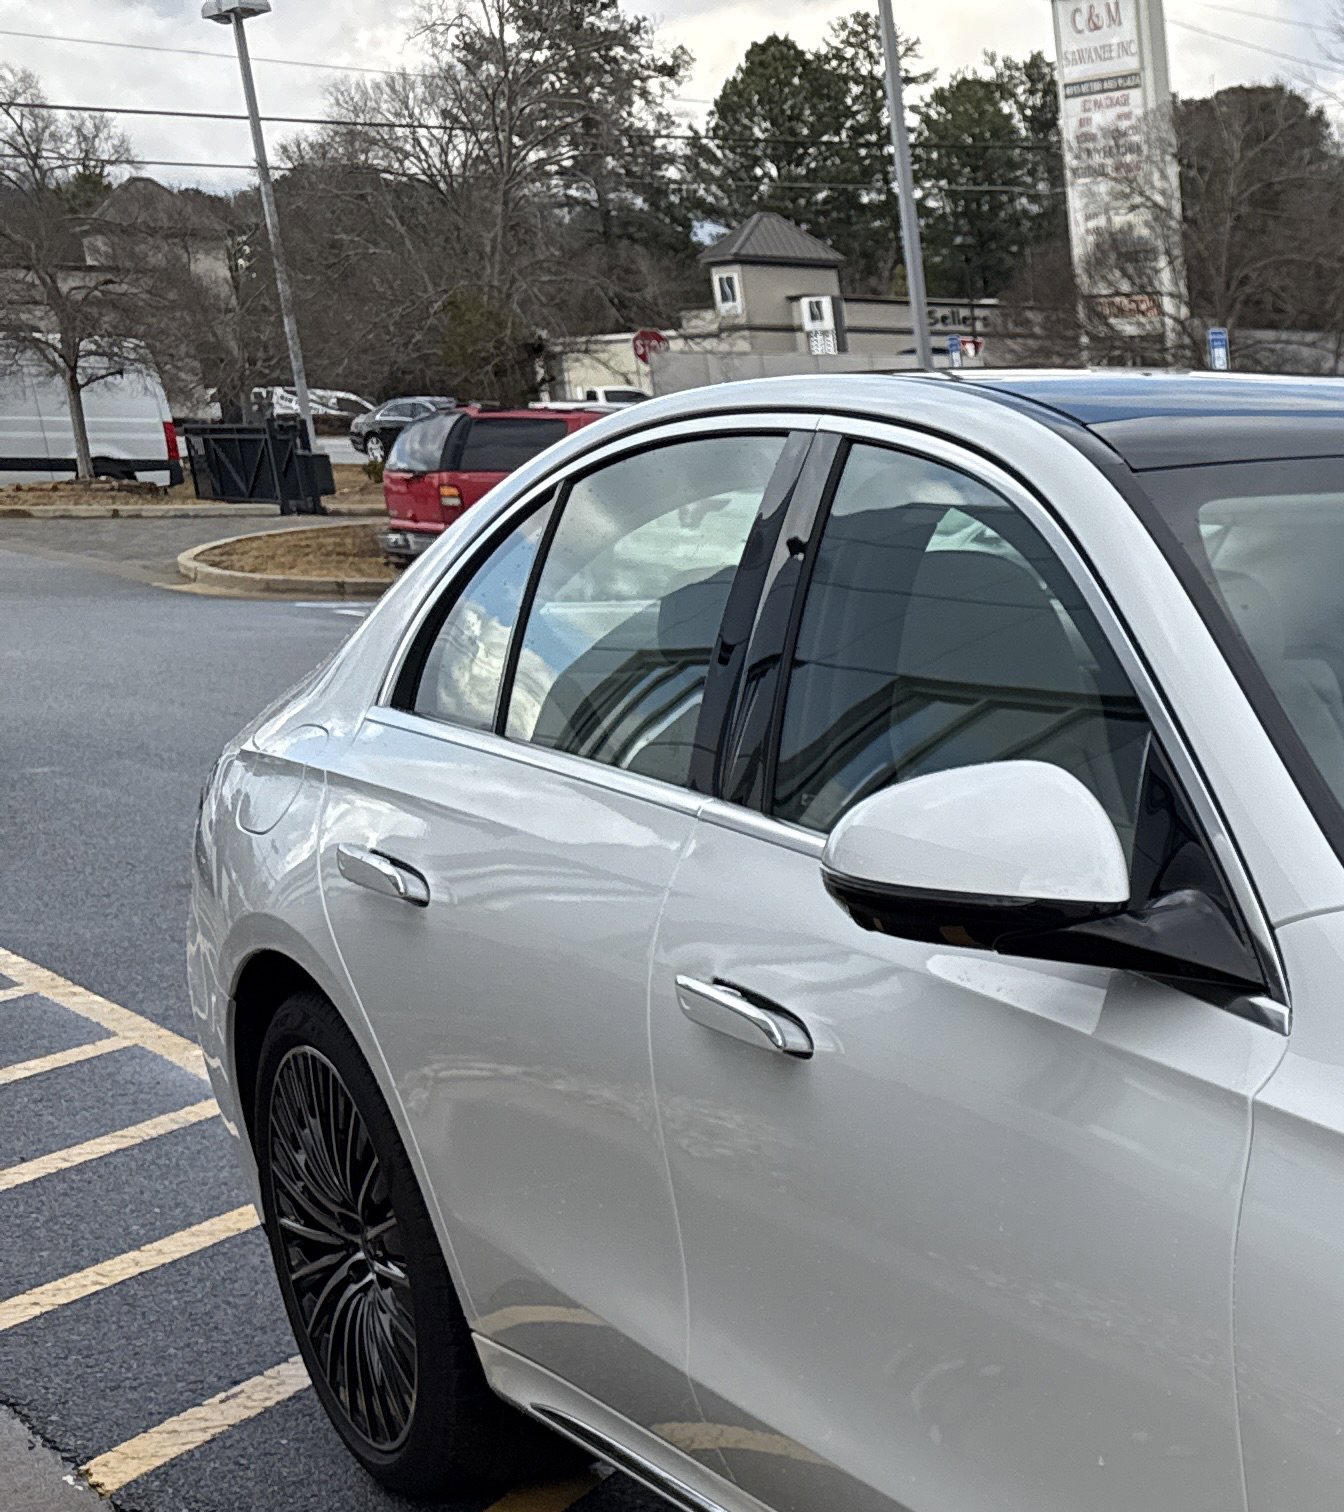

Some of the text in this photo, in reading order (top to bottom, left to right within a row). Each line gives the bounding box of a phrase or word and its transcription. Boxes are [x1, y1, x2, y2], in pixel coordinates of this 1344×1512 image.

[1071, 0, 1123, 34] C & M
[1117, 39, 1137, 59] INC
